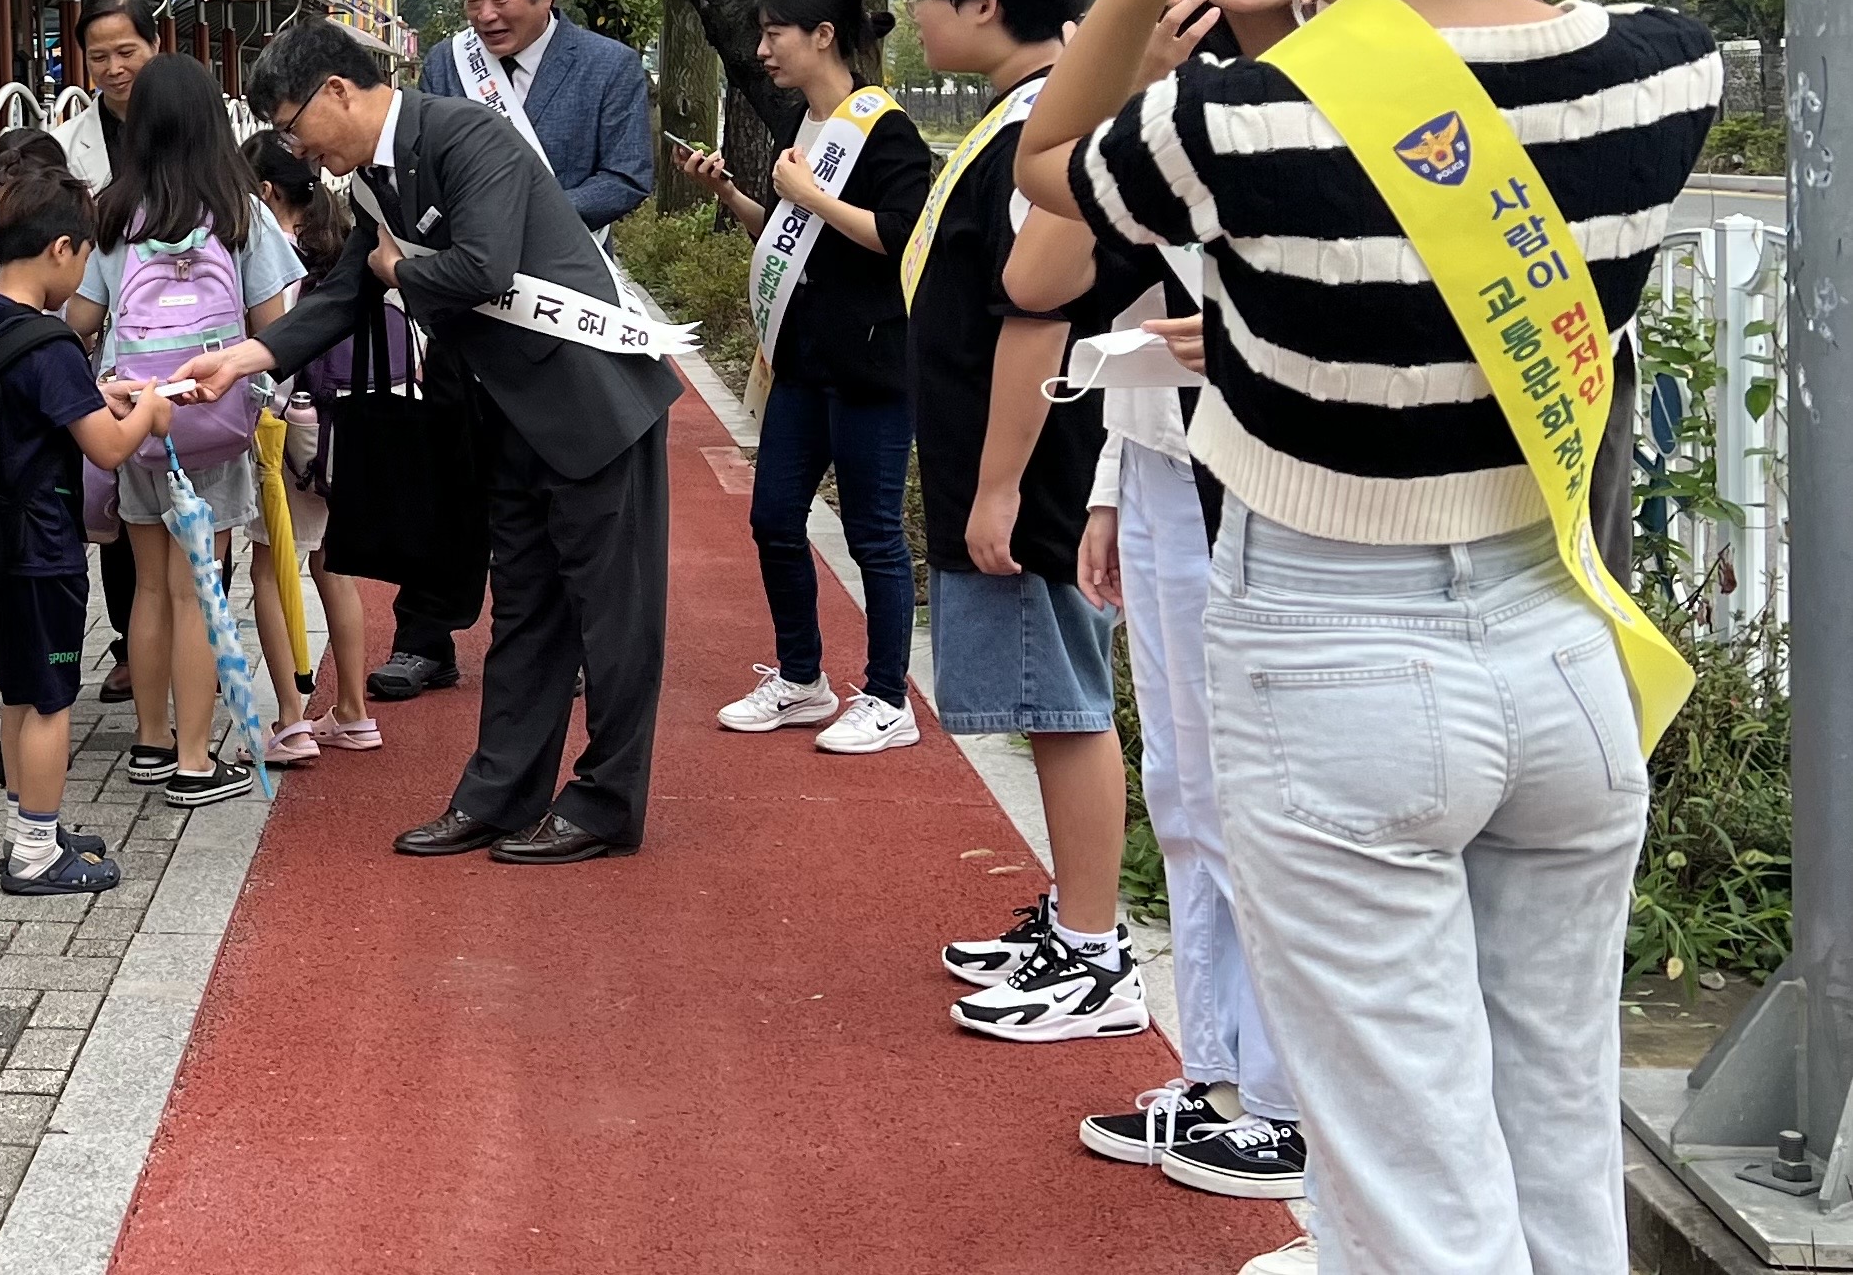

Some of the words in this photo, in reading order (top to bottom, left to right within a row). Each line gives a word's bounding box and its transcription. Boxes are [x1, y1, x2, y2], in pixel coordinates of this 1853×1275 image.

[813, 141, 846, 183] 함께
[1489, 176, 1570, 291] 사람이
[1551, 302, 1606, 408] 먼저인
[49, 651, 80, 665] SPORT
